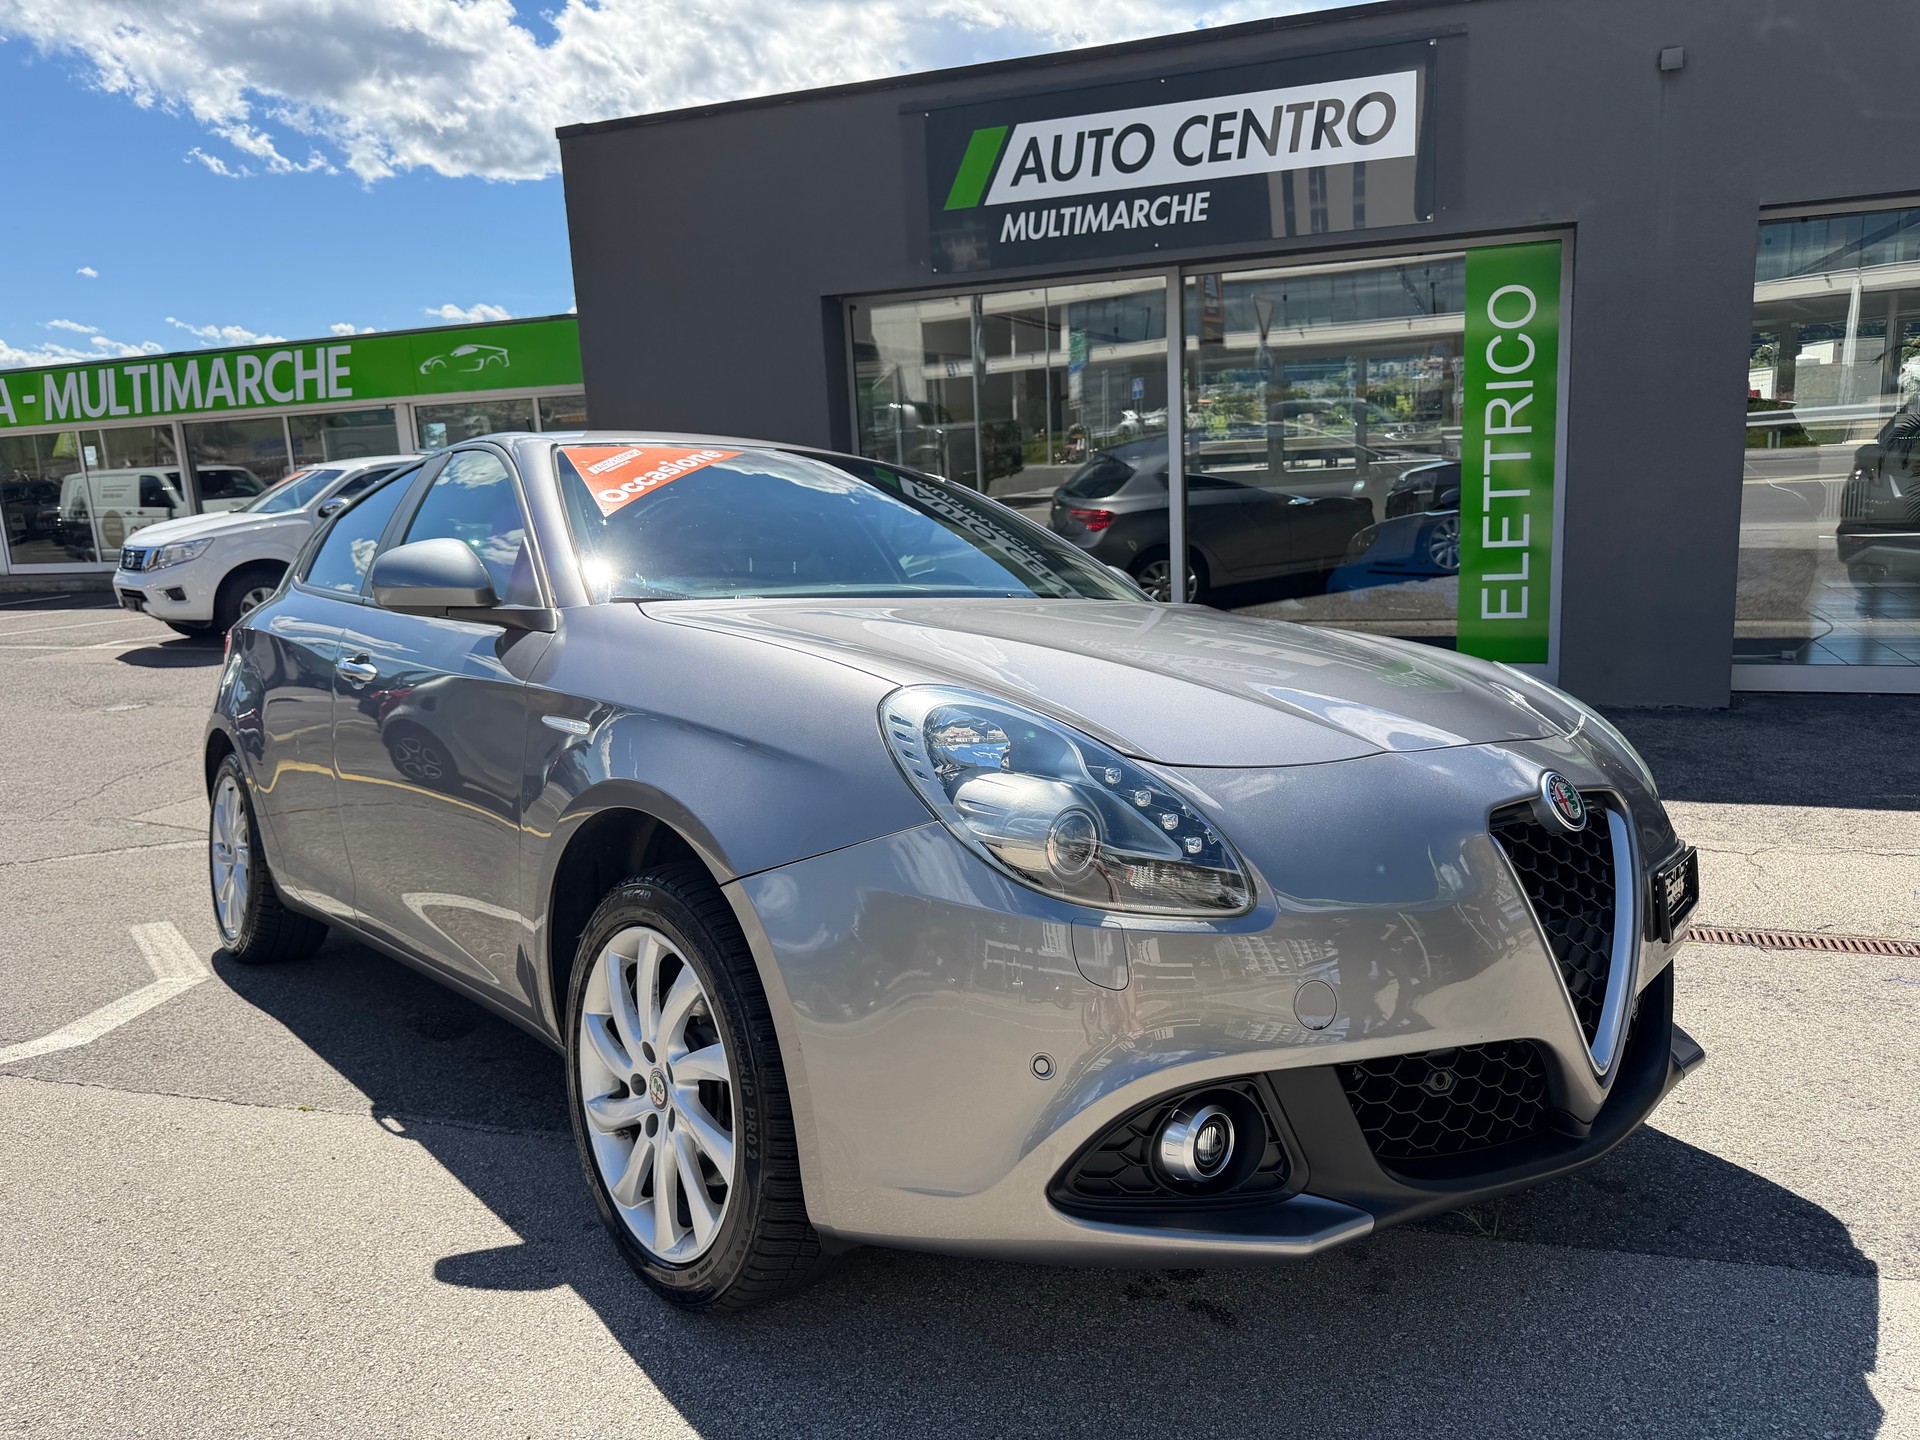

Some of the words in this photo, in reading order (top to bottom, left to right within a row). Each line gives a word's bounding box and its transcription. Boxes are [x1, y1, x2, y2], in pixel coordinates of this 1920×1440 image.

[1010, 122, 1156, 187] AUTO
[1172, 91, 1398, 167] CENTRO
[1000, 191, 1211, 243] MULTIMARCHE
[44, 345, 353, 421] MULTIMARCHE
[597, 450, 724, 503] Occasione
[1480, 284, 1537, 620] ELETTRICO
[744, 1106, 759, 1147] PRO
[746, 1151, 759, 1161] 2
